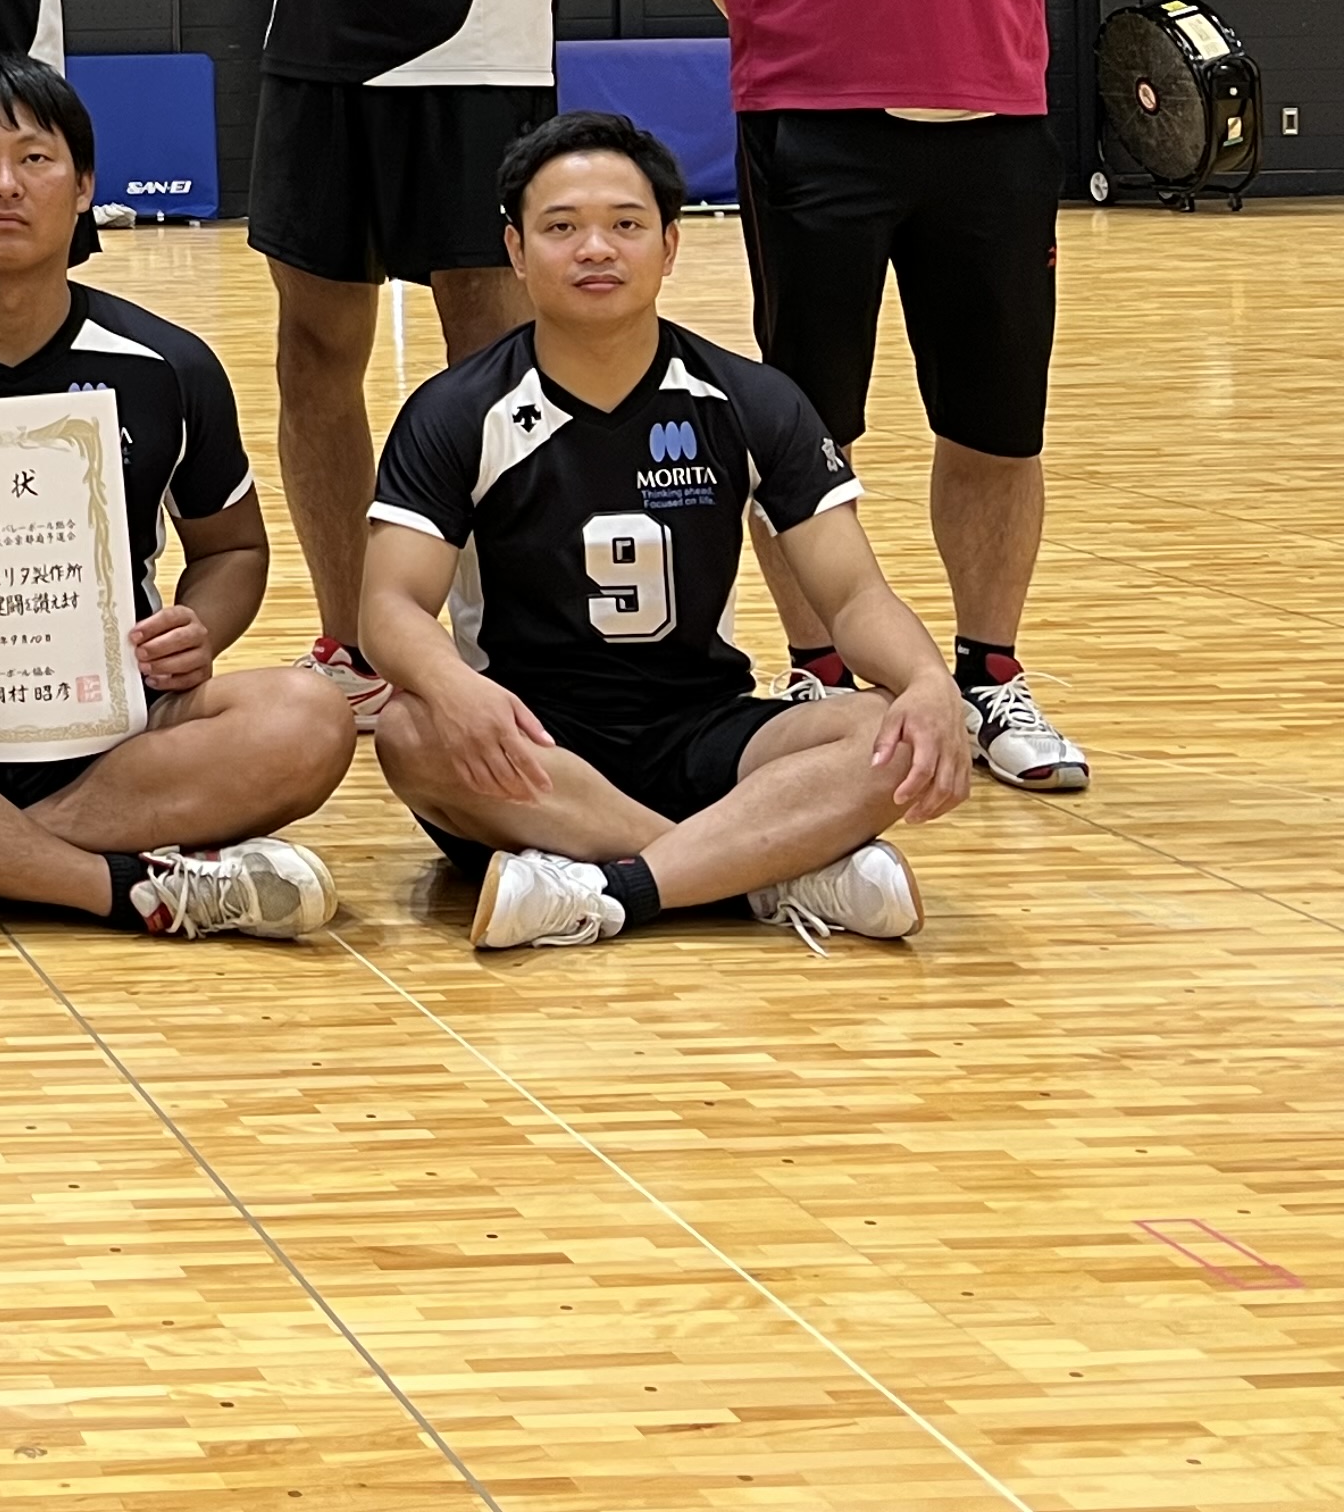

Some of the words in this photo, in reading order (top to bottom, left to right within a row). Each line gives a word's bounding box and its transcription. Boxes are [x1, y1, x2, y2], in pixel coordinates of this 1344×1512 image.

[637, 466, 718, 489] MORITA
[641, 488, 683, 500] Thinking
[643, 498, 683, 509] Focused
[582, 514, 677, 643] 9
